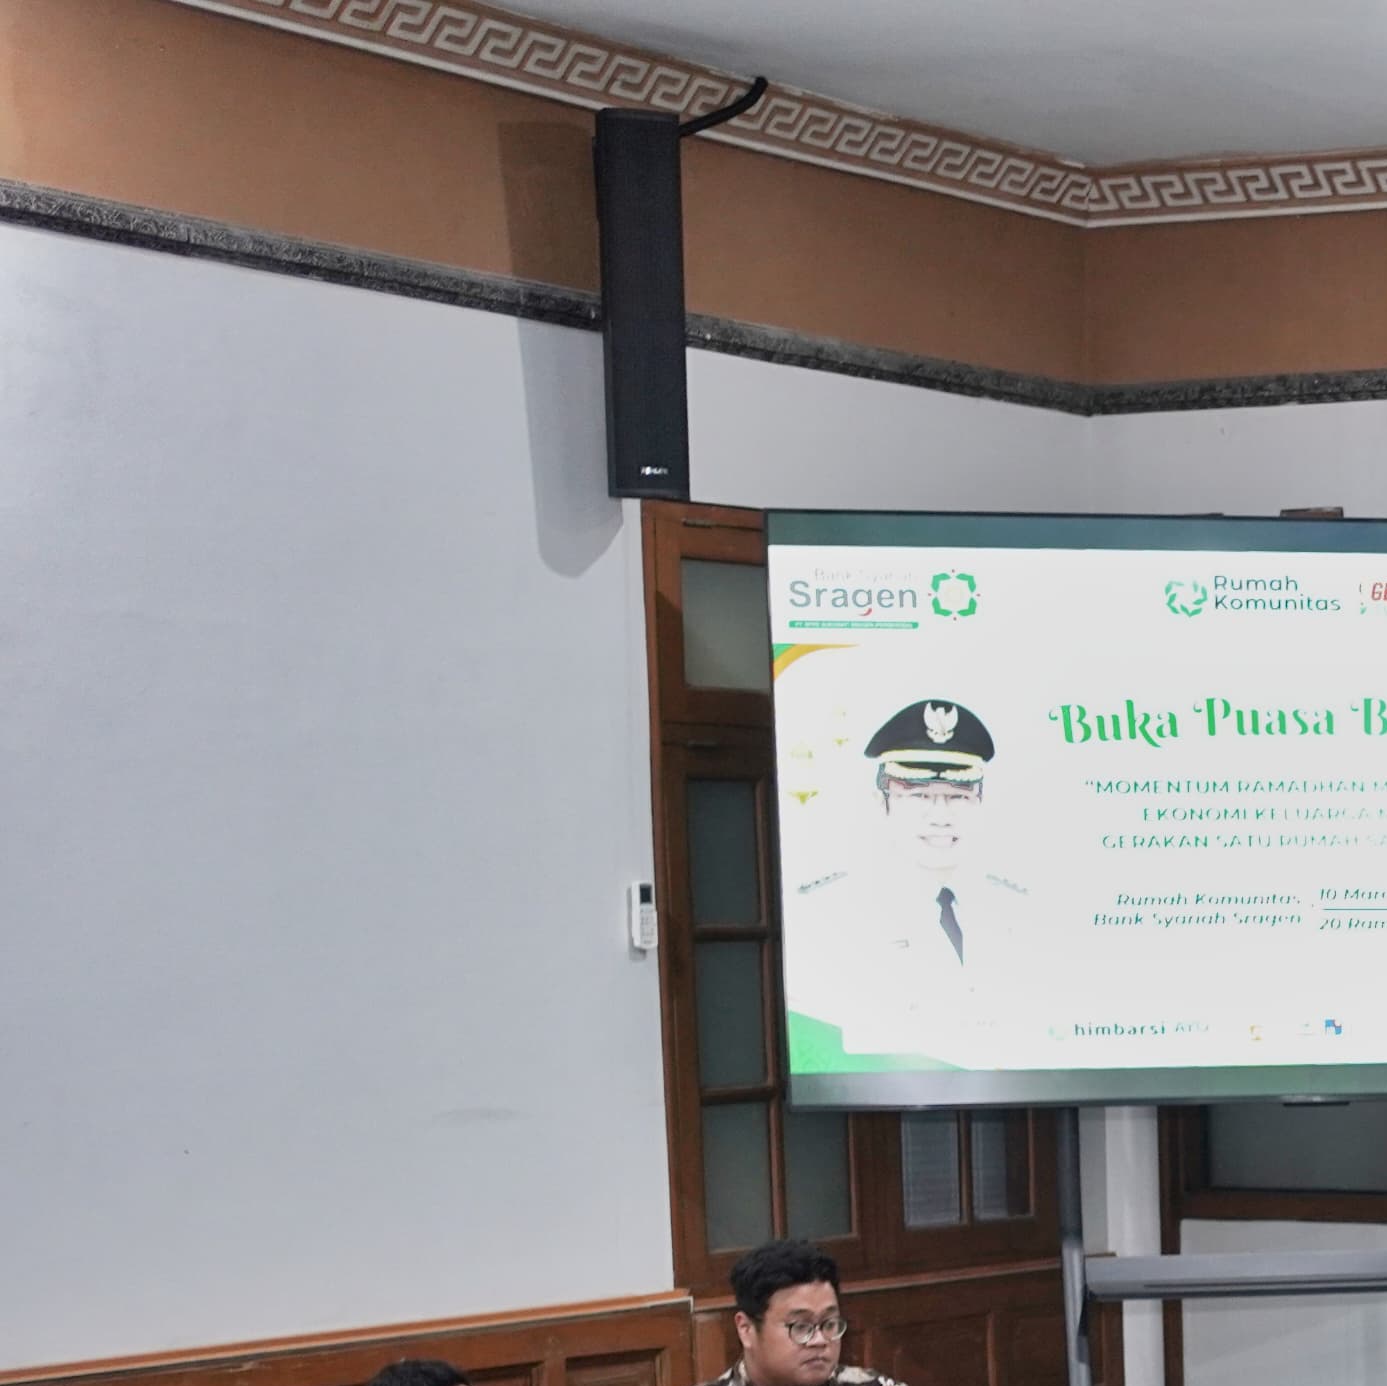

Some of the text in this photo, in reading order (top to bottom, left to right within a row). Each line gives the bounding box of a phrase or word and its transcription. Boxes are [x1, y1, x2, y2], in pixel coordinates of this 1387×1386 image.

[1214, 575, 1298, 591] Rumah
[789, 580, 917, 616] Sragen
[1214, 594, 1341, 611] Komunitas
[1049, 700, 1179, 748] Buka
[1193, 697, 1335, 736] Puasa
[1143, 807, 1247, 821] EKONOMI
[1102, 835, 1208, 848] GERAKAN
[1117, 892, 1188, 906] Rumah
[1320, 888, 1337, 900] 10
[1094, 913, 1143, 926] Bank
[1320, 917, 1341, 930] 20
[1074, 1023, 1166, 1036] himbarsi
